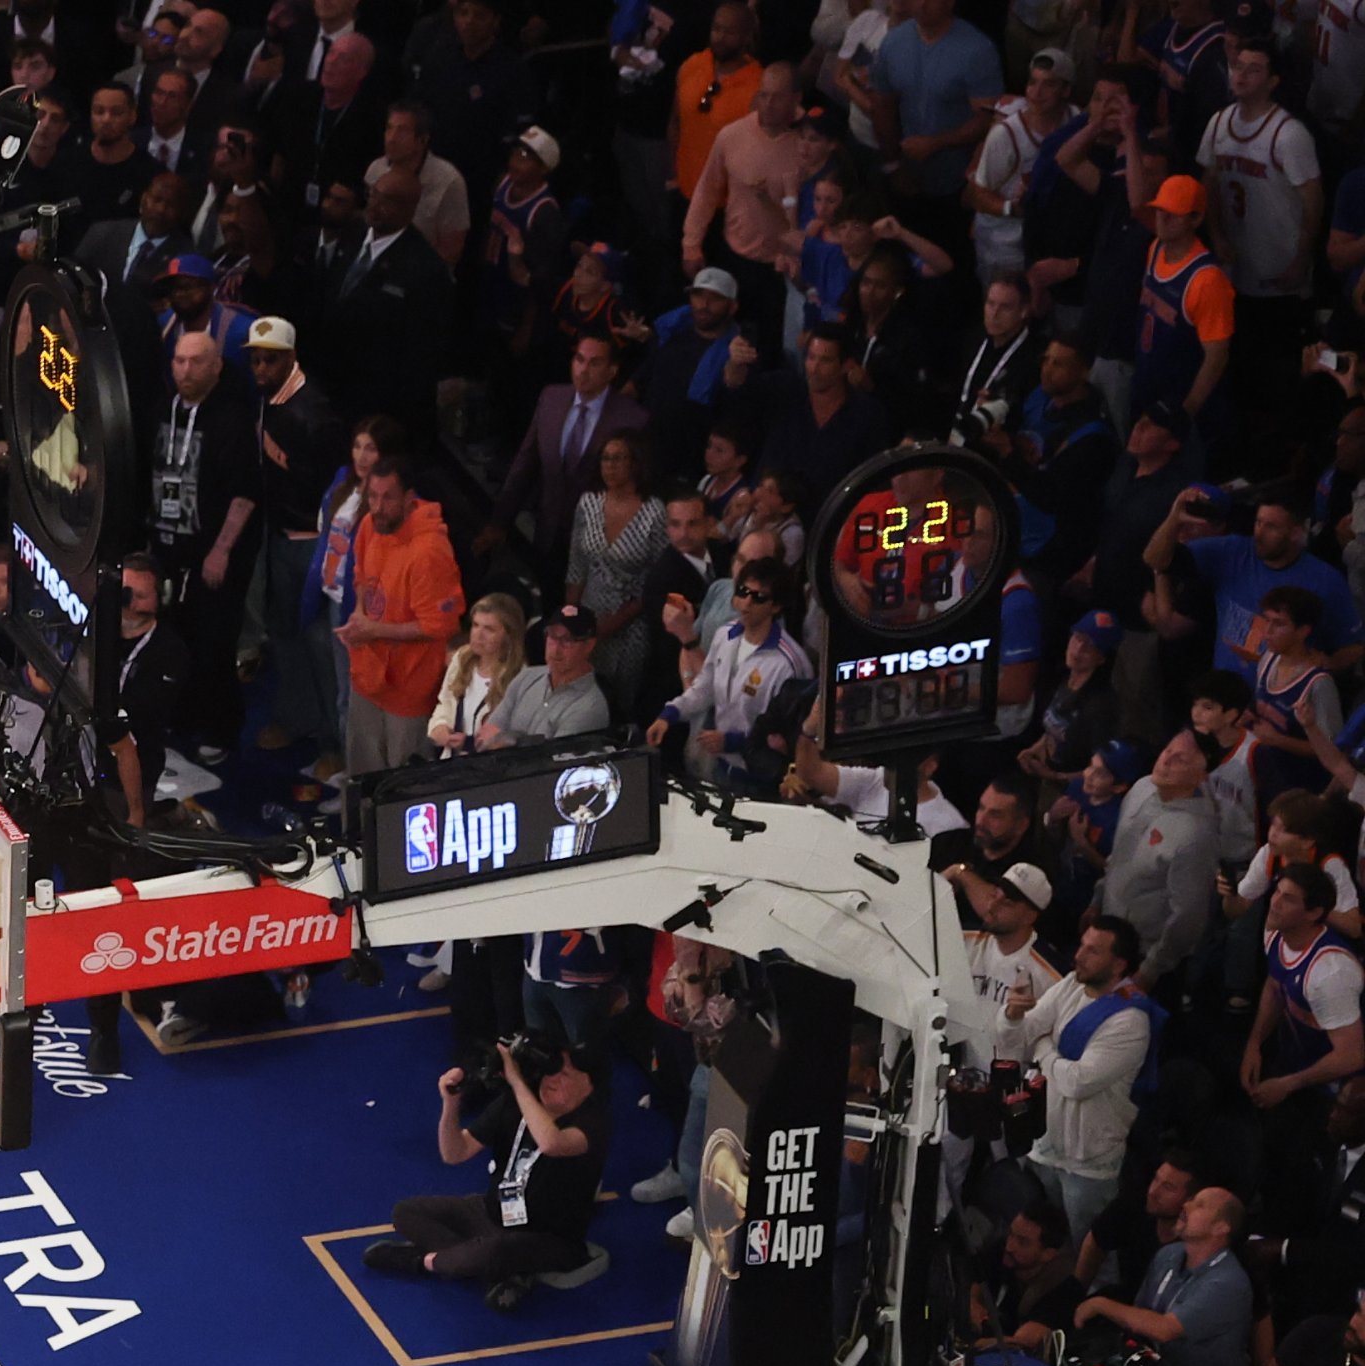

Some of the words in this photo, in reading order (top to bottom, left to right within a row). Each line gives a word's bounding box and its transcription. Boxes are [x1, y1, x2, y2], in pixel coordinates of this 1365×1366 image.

[881, 500, 949, 551] 2.2
[880, 638, 991, 676] TISSOT
[441, 798, 518, 874] App
[766, 1126, 821, 1172] GET
[764, 1171, 818, 1216] THE
[769, 1218, 825, 1270] App
